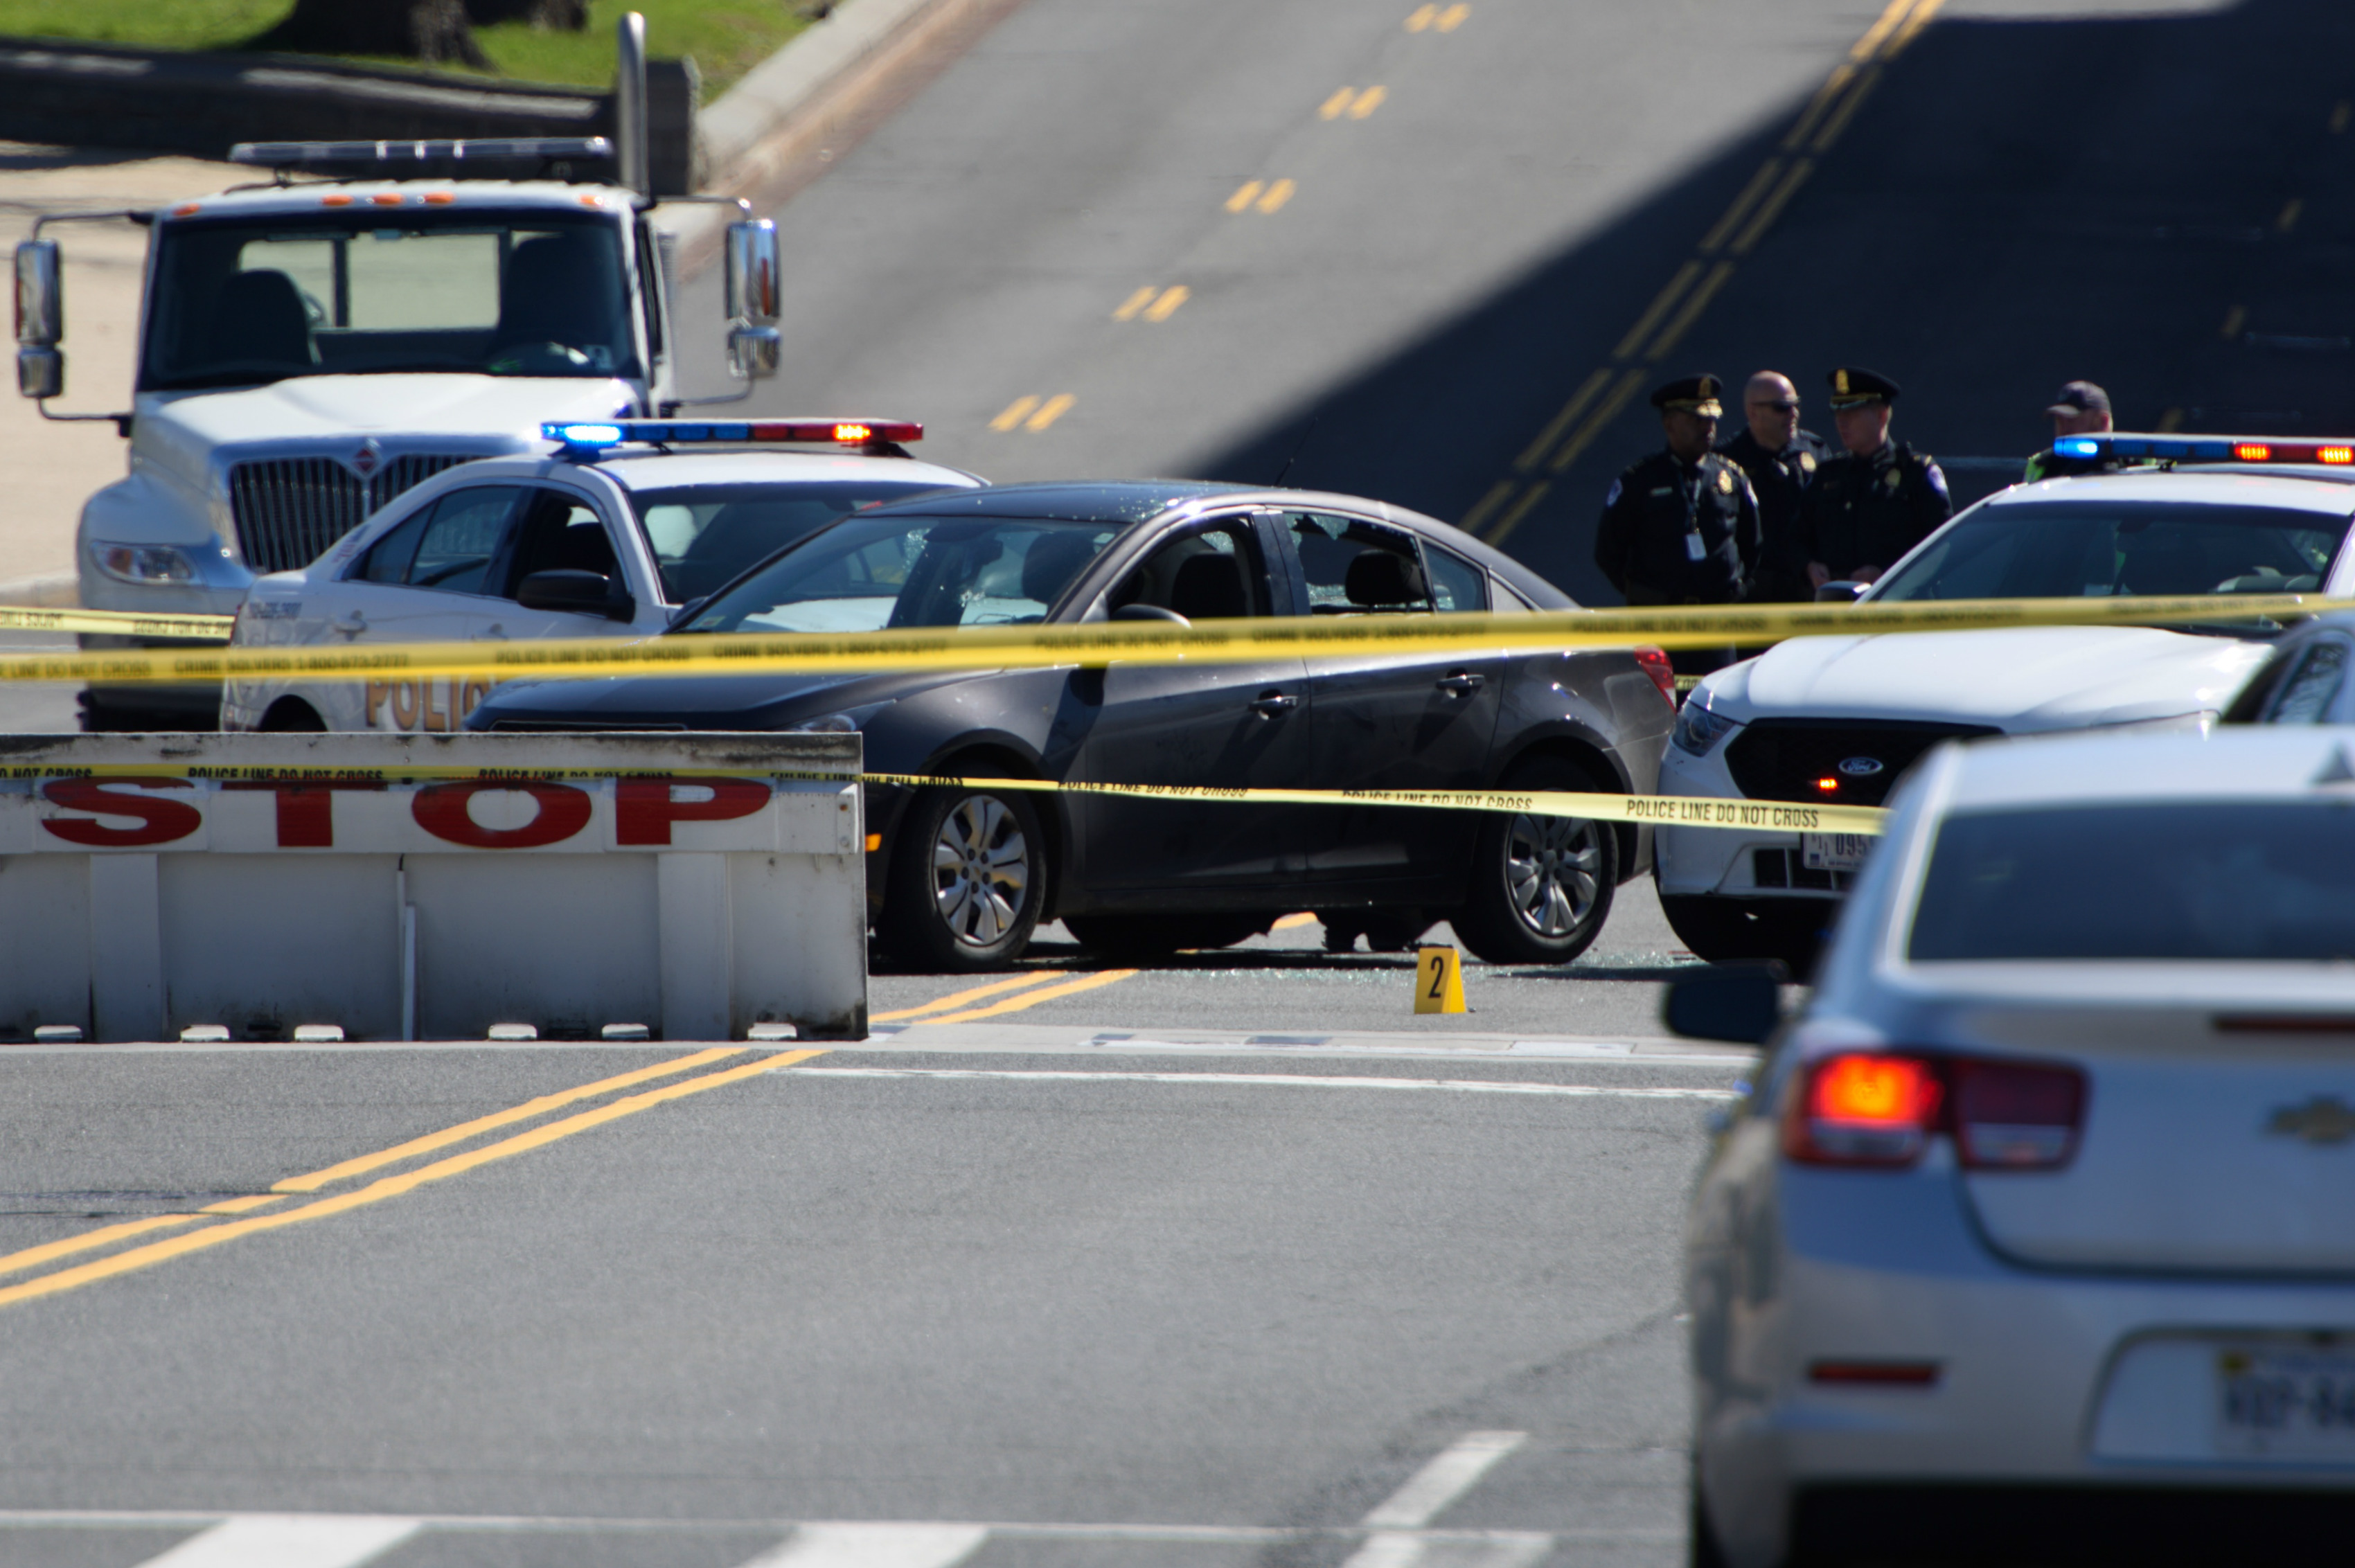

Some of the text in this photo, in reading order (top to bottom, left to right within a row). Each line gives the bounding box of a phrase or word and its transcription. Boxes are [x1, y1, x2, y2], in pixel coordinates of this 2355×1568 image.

[364, 677, 501, 732] POLIC
[42, 776, 773, 849] STOP
[1486, 795, 1534, 810] CROSS
[1626, 799, 1819, 828] POLICE LINE DO NOT CROSS
[1428, 956, 1444, 999] 2
